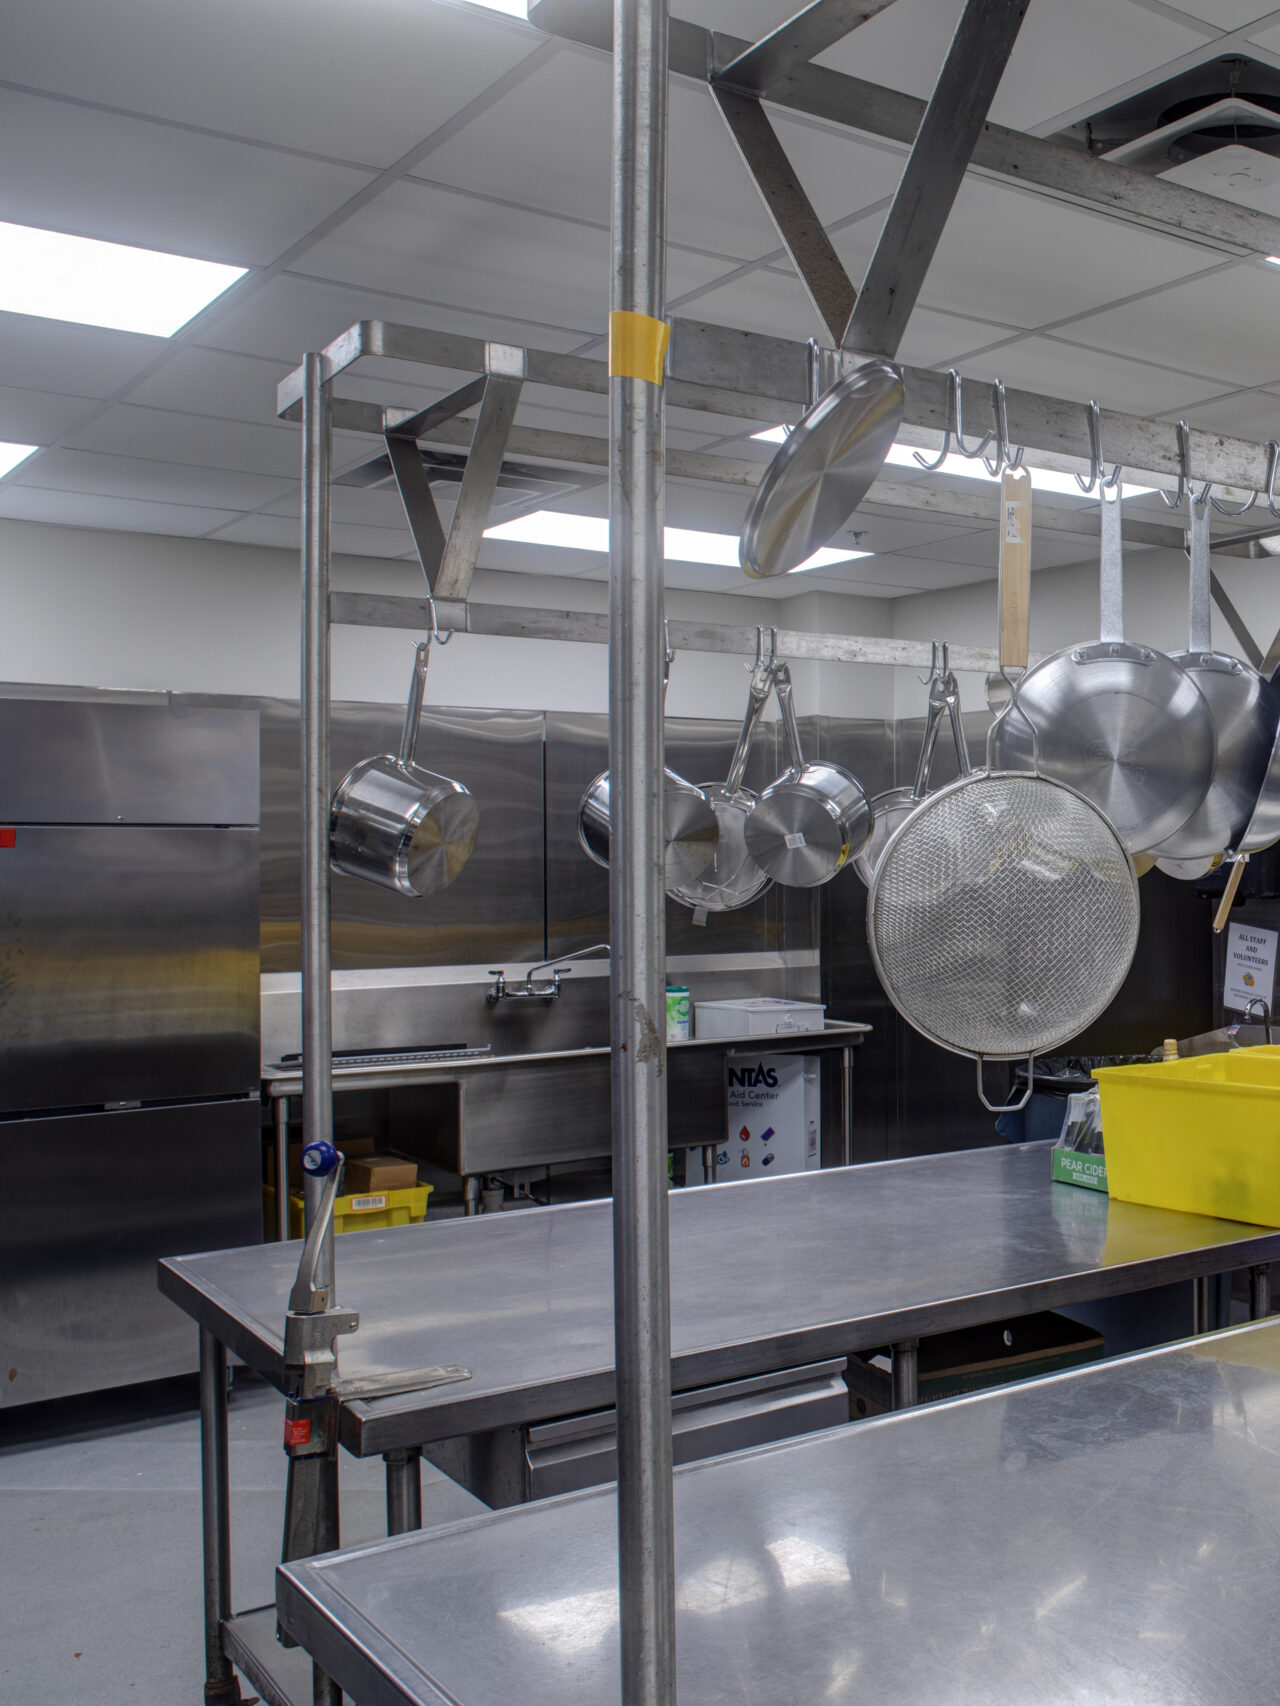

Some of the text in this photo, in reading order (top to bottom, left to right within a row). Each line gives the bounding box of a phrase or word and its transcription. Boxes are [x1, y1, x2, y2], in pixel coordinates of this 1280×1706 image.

[1238, 934, 1268, 945] ALL STAFF
[1245, 944, 1258, 953] AND
[1233, 952, 1269, 966] VOLUNTEERS
[729, 1090, 779, 1100] Aid Center
[1061, 1157, 1083, 1173] PEAR
